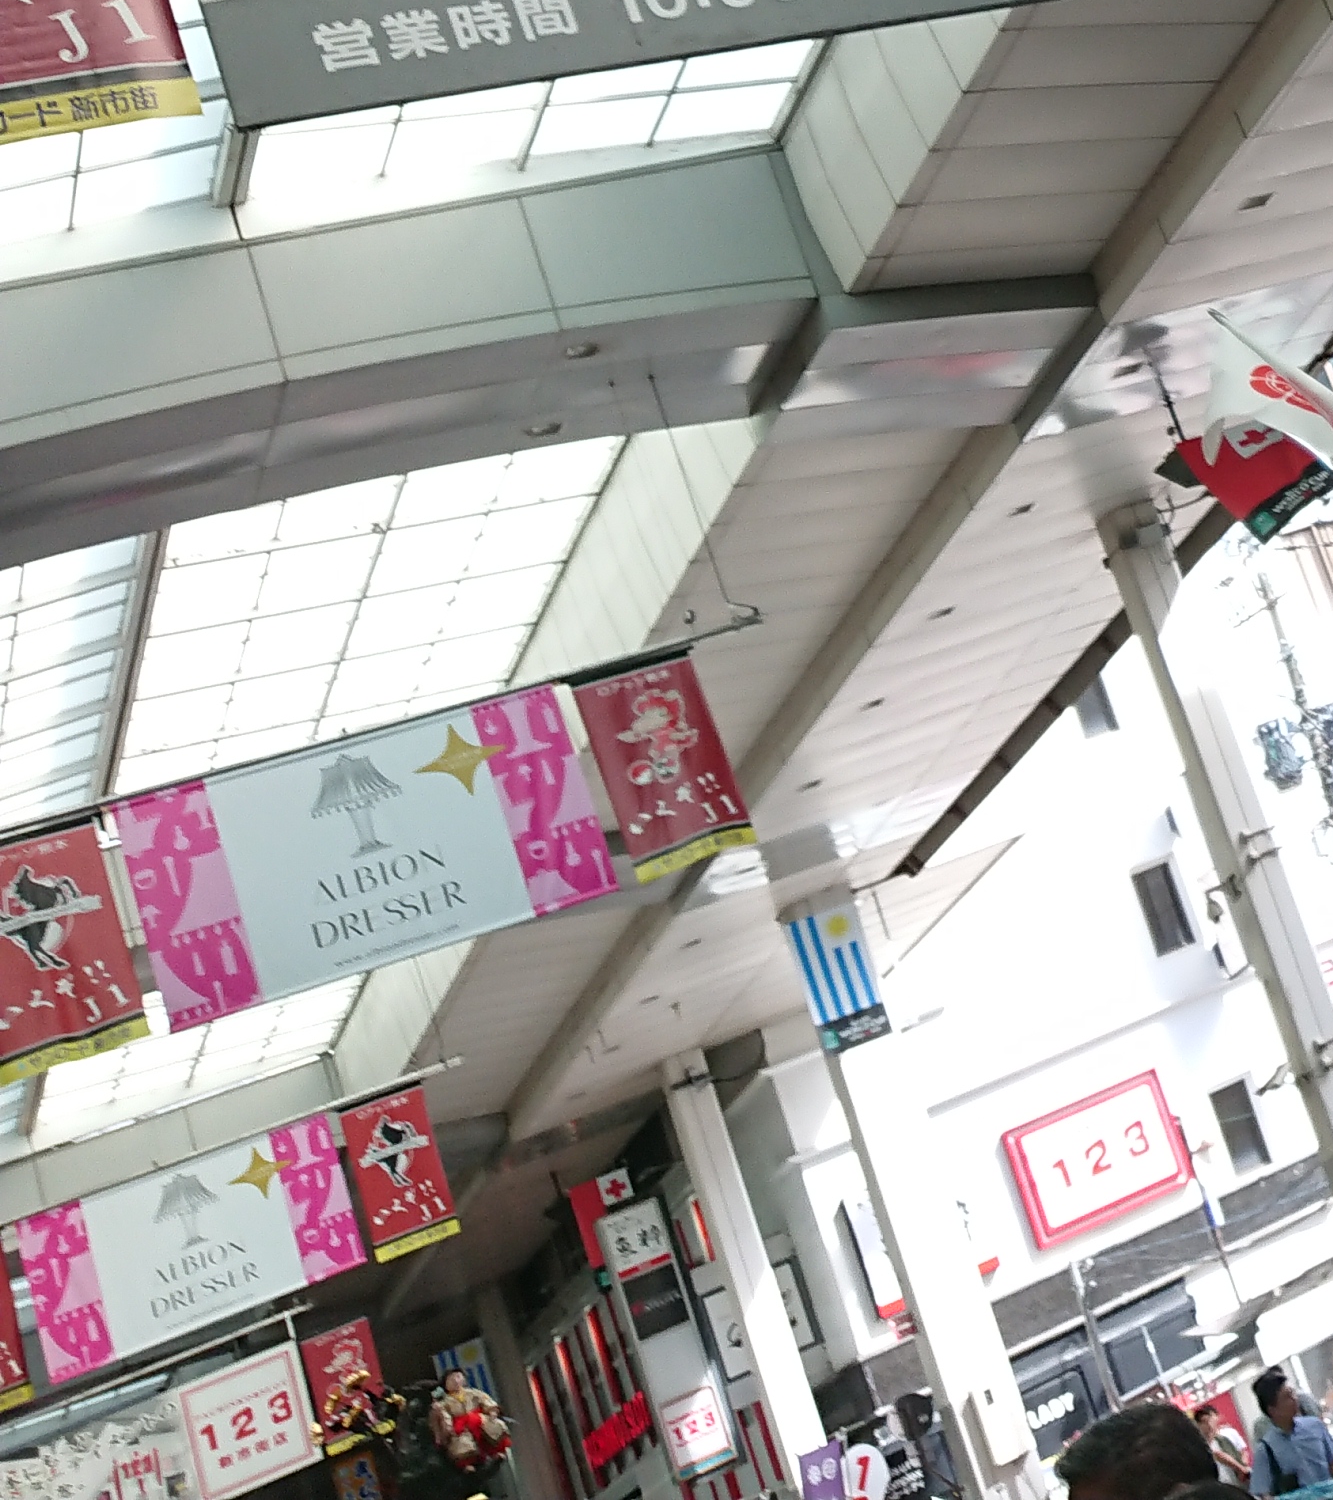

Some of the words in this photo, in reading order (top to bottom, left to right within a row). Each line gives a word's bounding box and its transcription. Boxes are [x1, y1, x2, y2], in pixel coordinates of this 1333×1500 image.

[701, 794, 738, 824] J1
[316, 844, 446, 902] ALBION
[310, 880, 467, 949] DRESSER
[83, 983, 131, 1024] J1
[1052, 1119, 1151, 1189] 123
[150, 1261, 260, 1319] DRESSER
[154, 1240, 248, 1284] ALBION
[200, 1389, 294, 1452] 123
[1026, 1391, 1075, 1430] LADY
